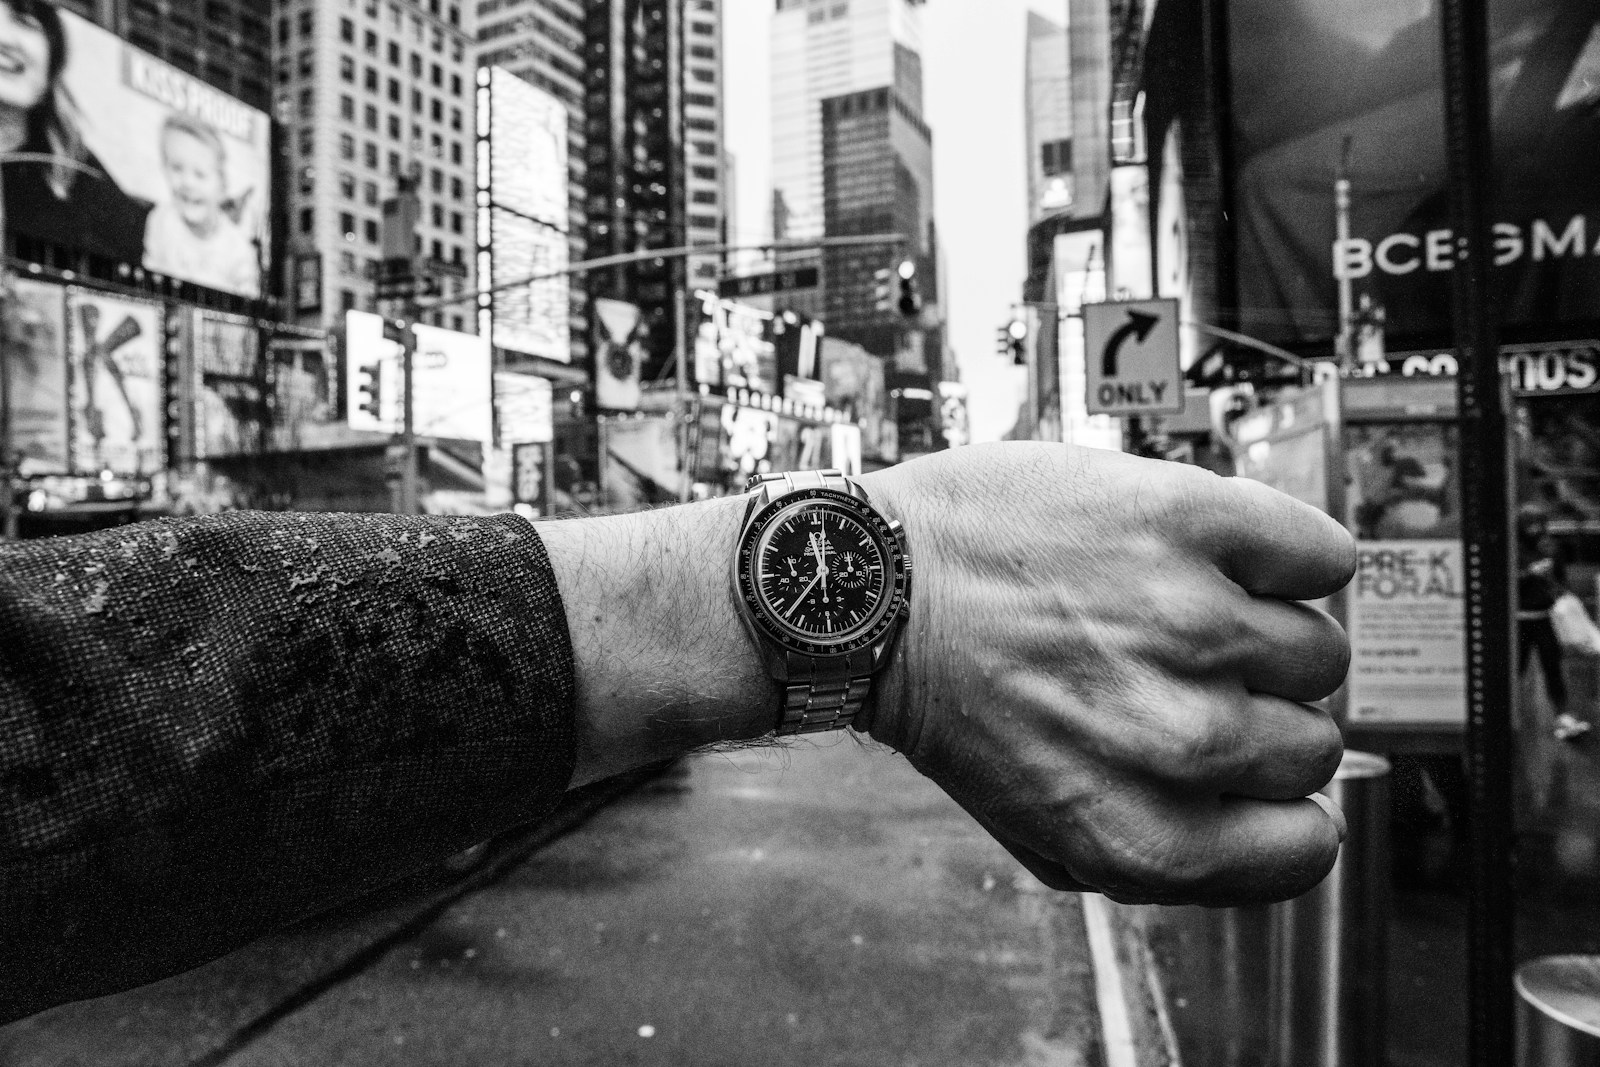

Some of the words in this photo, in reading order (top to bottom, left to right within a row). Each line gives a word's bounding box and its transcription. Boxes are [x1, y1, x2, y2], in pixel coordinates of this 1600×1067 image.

[1097, 380, 1169, 407] ONLY
[1357, 551, 1451, 574] PRE-K
[1357, 575, 1418, 600] FOR
[1422, 576, 1464, 600] AL
